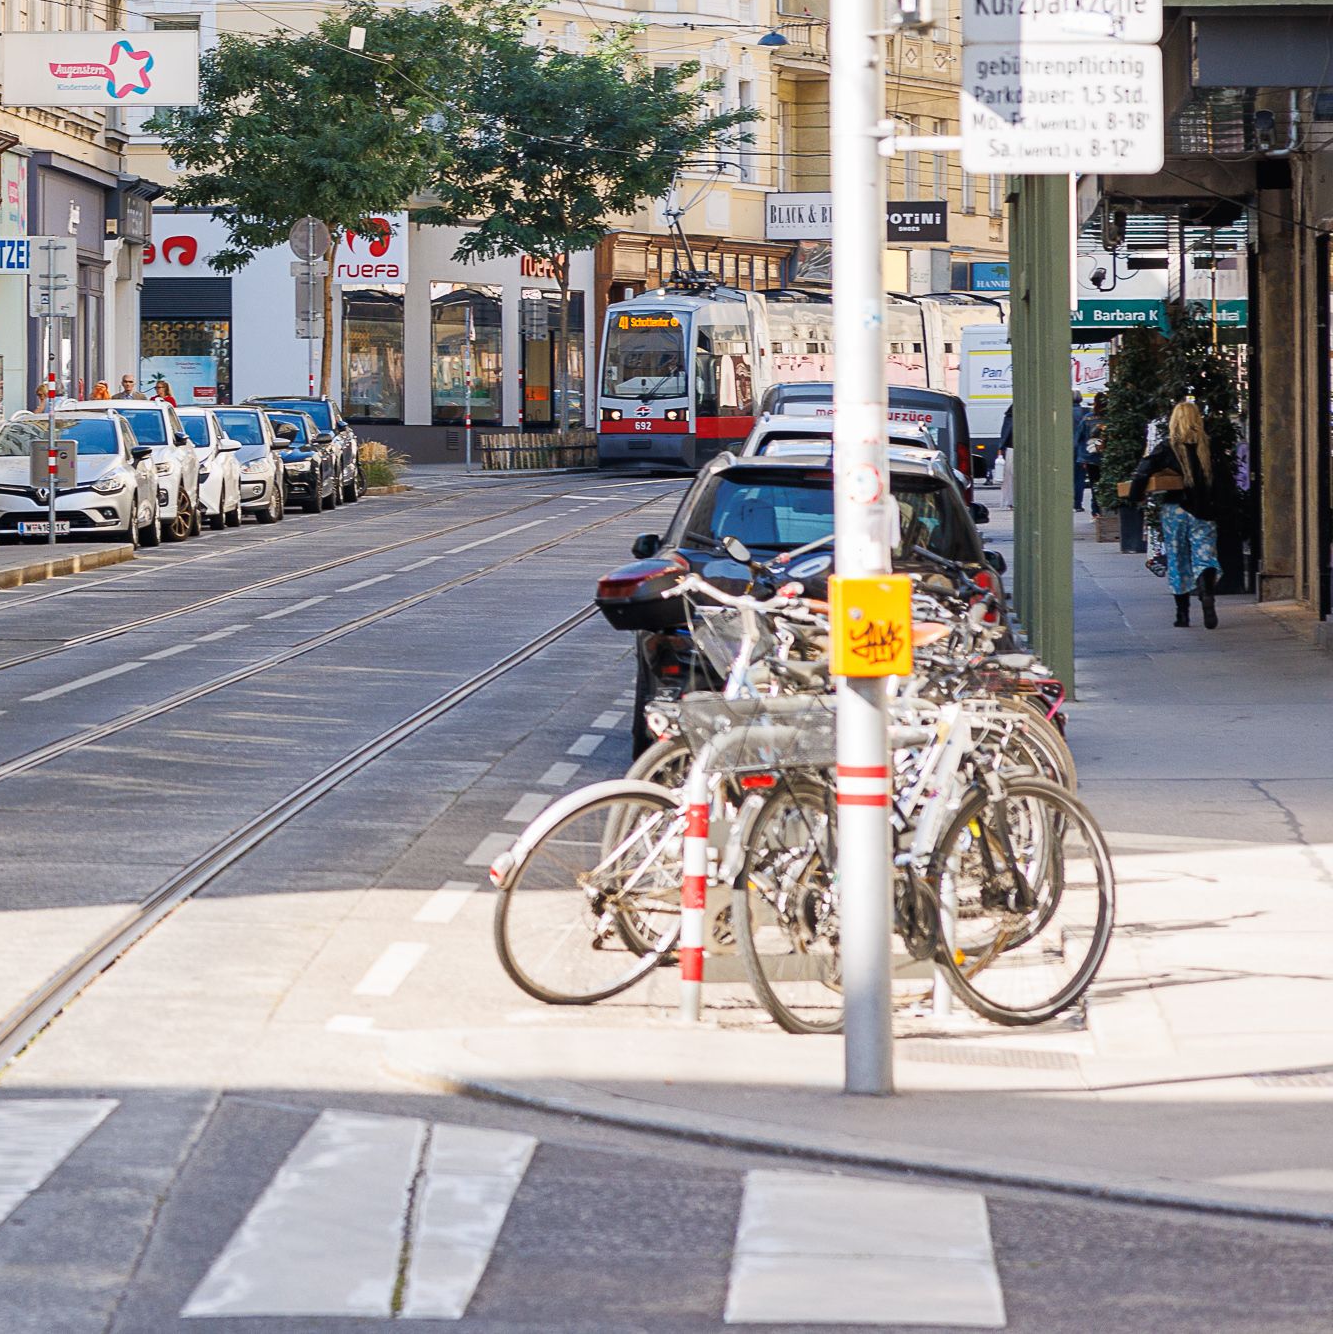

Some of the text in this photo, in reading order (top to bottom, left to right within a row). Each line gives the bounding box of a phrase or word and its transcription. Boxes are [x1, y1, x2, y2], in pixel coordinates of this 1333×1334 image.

[53, 64, 108, 78] Augenstern
[976, 53, 1145, 80] gebührenpflichtig
[56, 83, 102, 91] Kindermode
[974, 85, 1074, 104] Parkdauer:
[770, 204, 805, 224] BLACK
[808, 204, 817, 224] &
[337, 264, 400, 279] ruefa
[1093, 309, 1146, 321] Barbara
[618, 316, 629, 330] 41
[634, 421, 652, 431] 692
